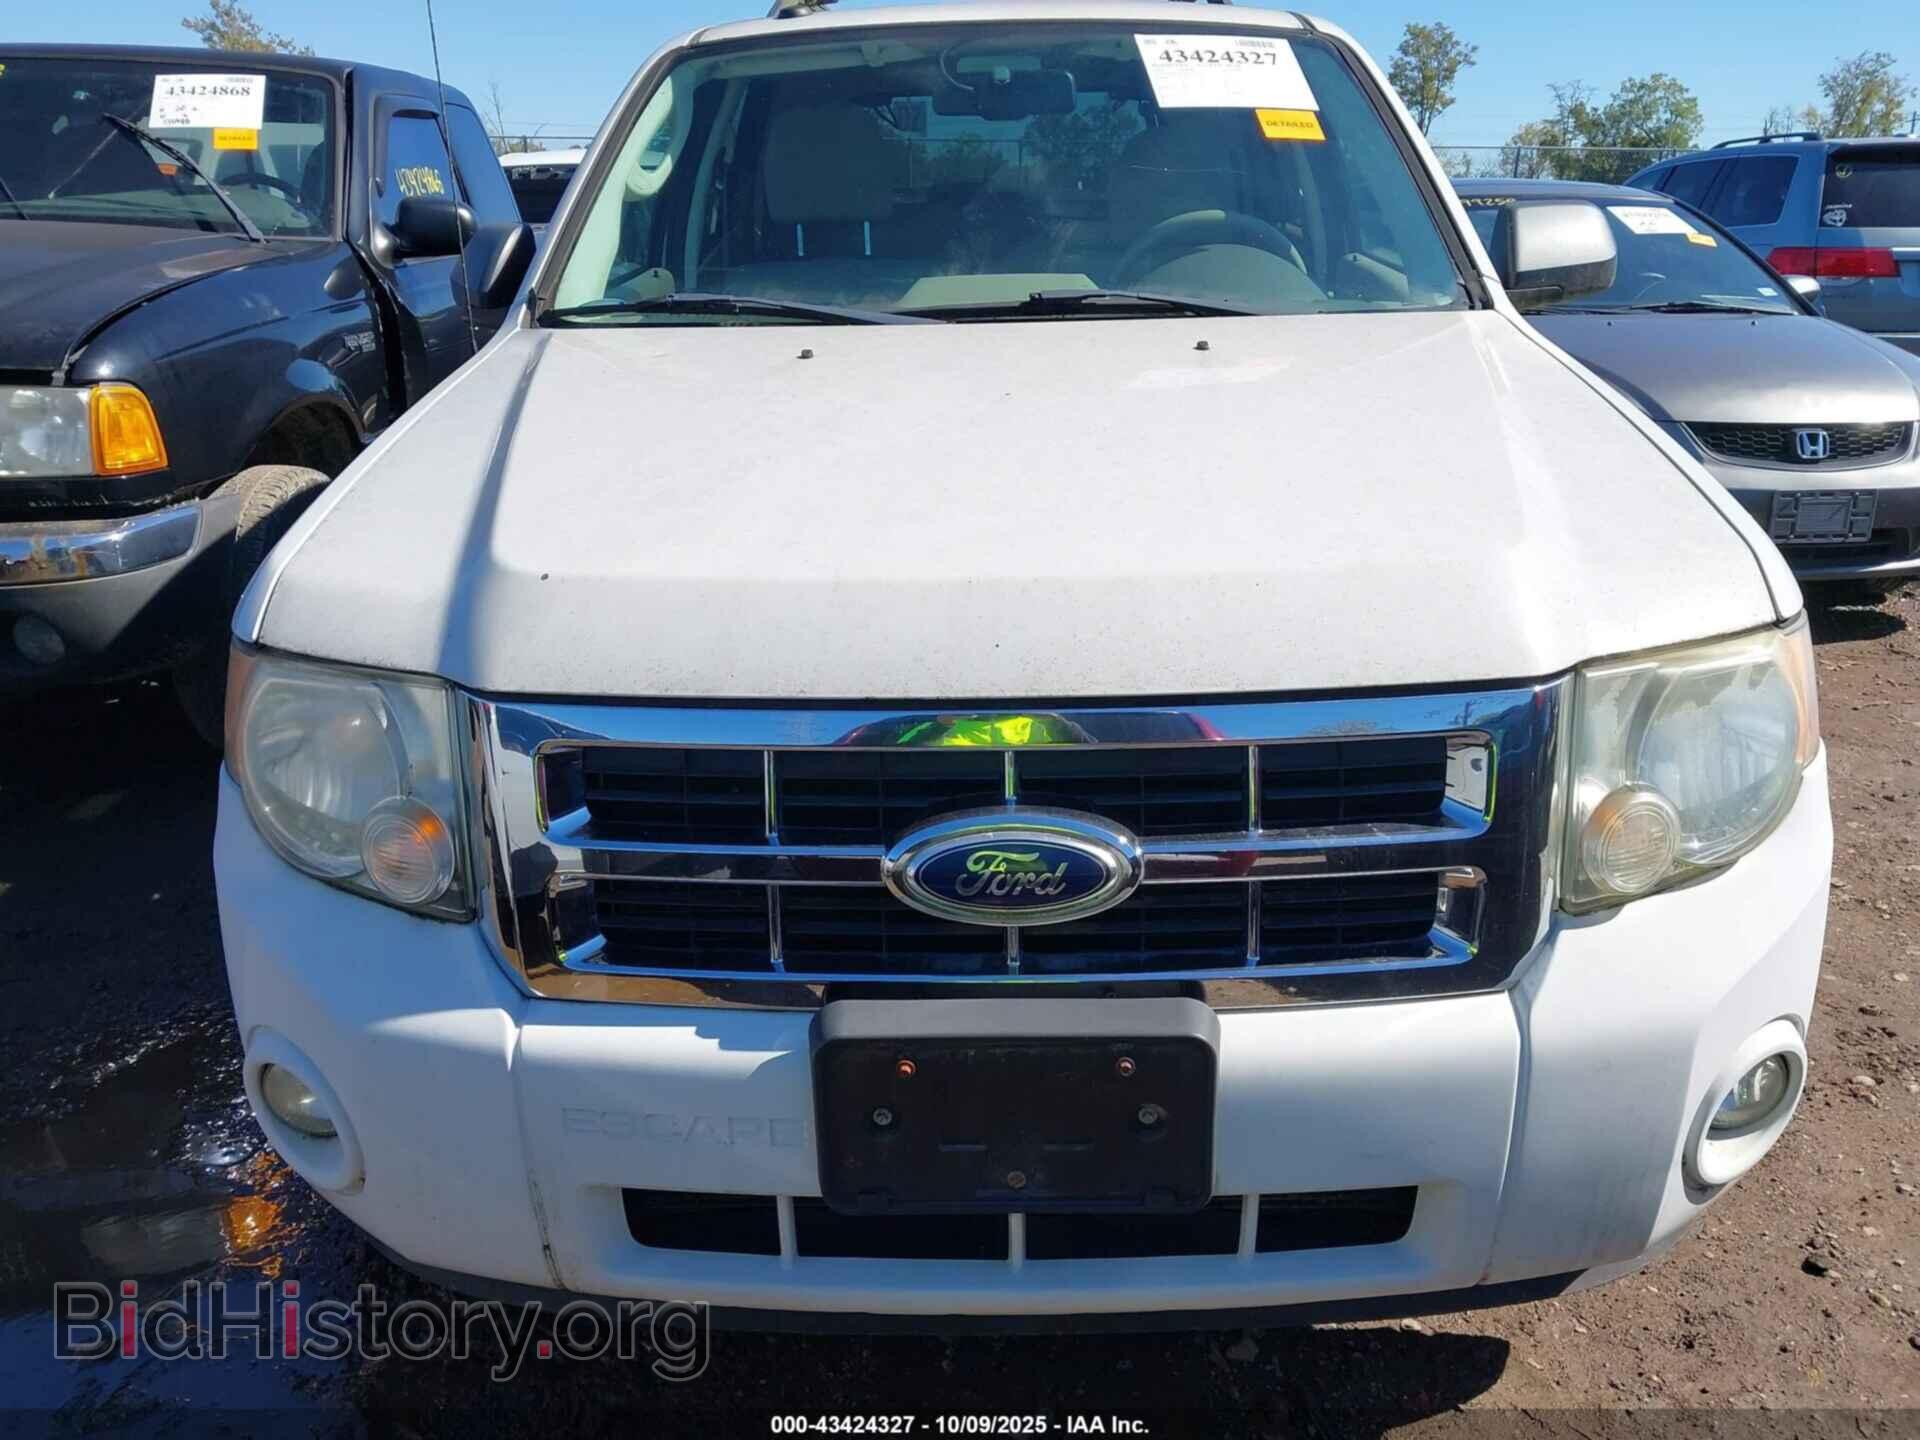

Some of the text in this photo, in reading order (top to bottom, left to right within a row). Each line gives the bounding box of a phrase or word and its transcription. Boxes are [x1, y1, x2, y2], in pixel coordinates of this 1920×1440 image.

[1159, 49, 1277, 65] 43424327
[166, 86, 251, 96] 43424868
[1265, 120, 1314, 129] DETAILED
[955, 850, 1068, 897] Ford
[560, 1105, 807, 1148] ESCAPE
